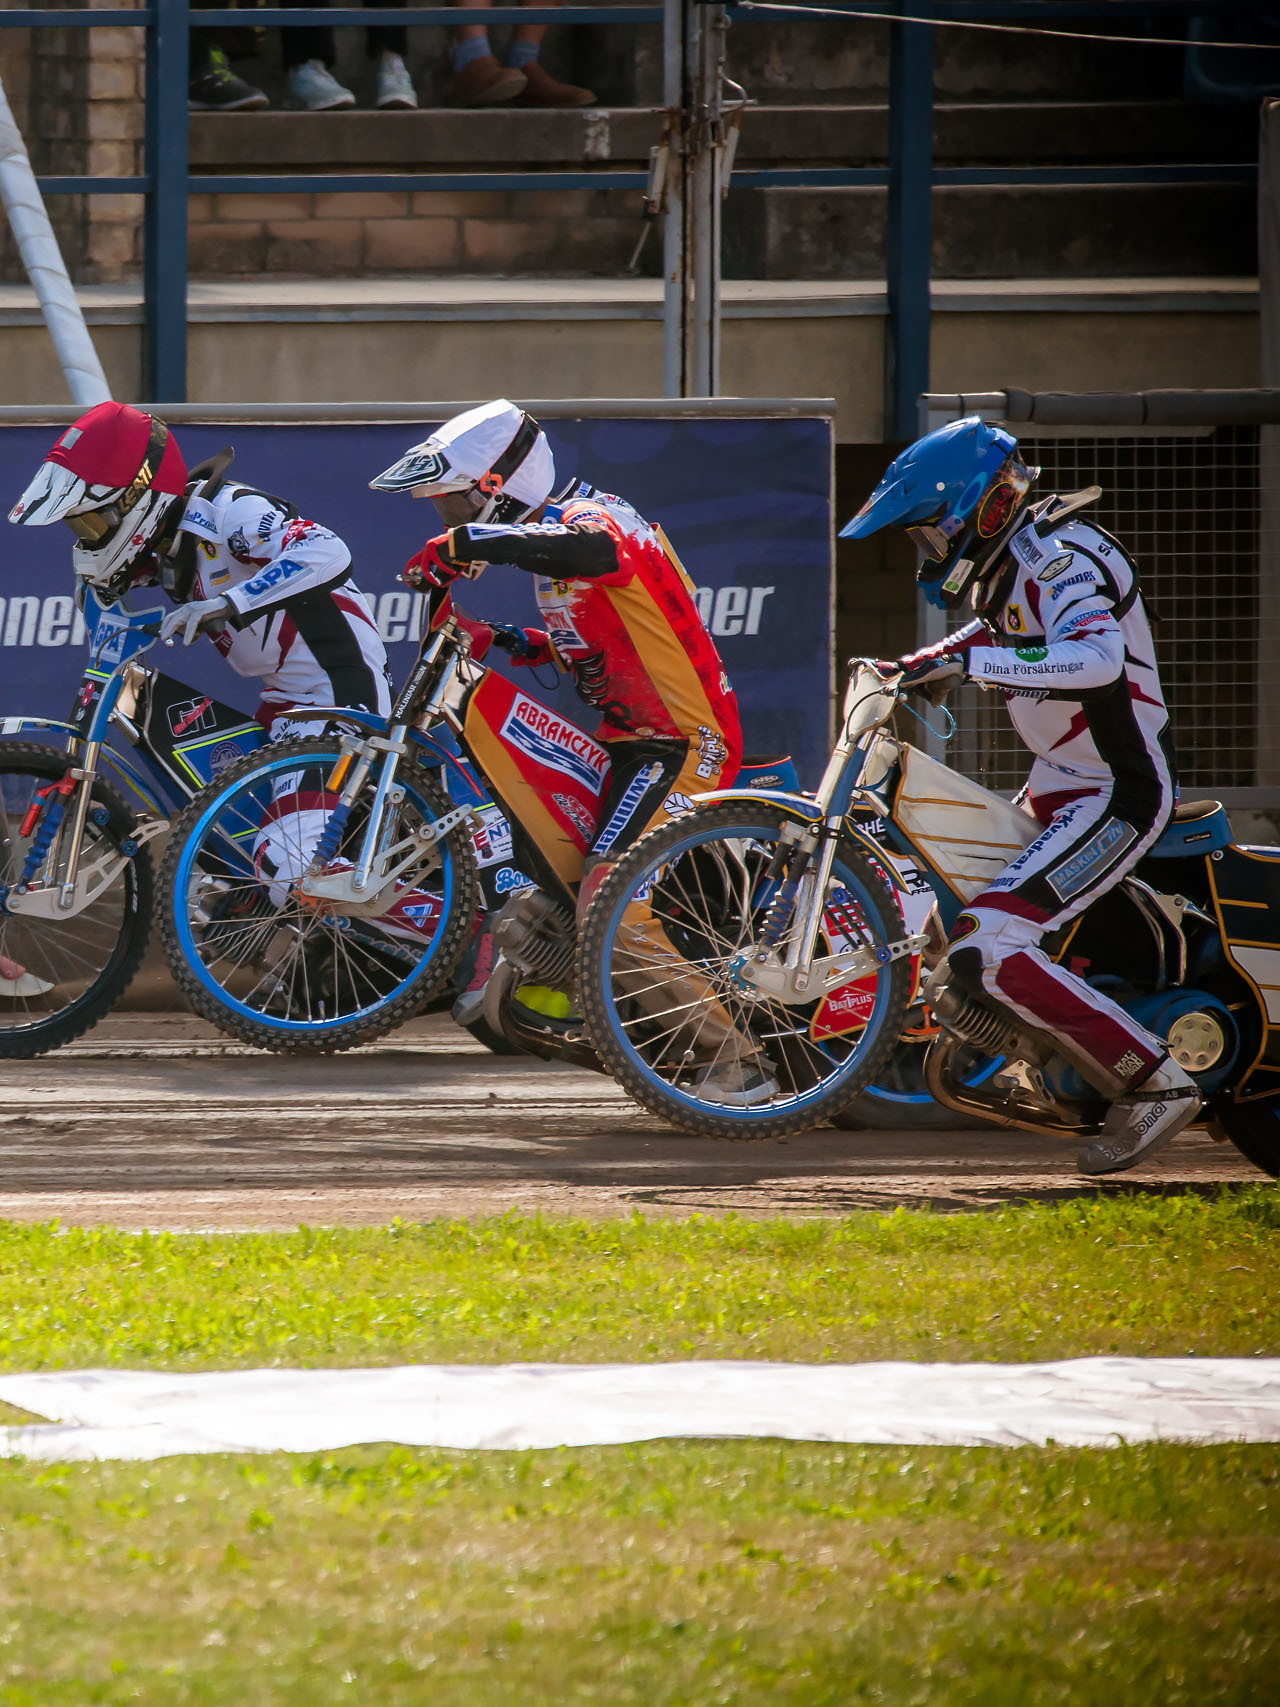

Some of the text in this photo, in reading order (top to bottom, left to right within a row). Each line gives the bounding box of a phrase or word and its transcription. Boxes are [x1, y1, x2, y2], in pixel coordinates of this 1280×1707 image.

[245, 558, 304, 595] GPA
[93, 620, 122, 653] GPA
[983, 661, 1084, 675] Dina Försäkringar
[515, 701, 610, 773] ABRAMCZYK
